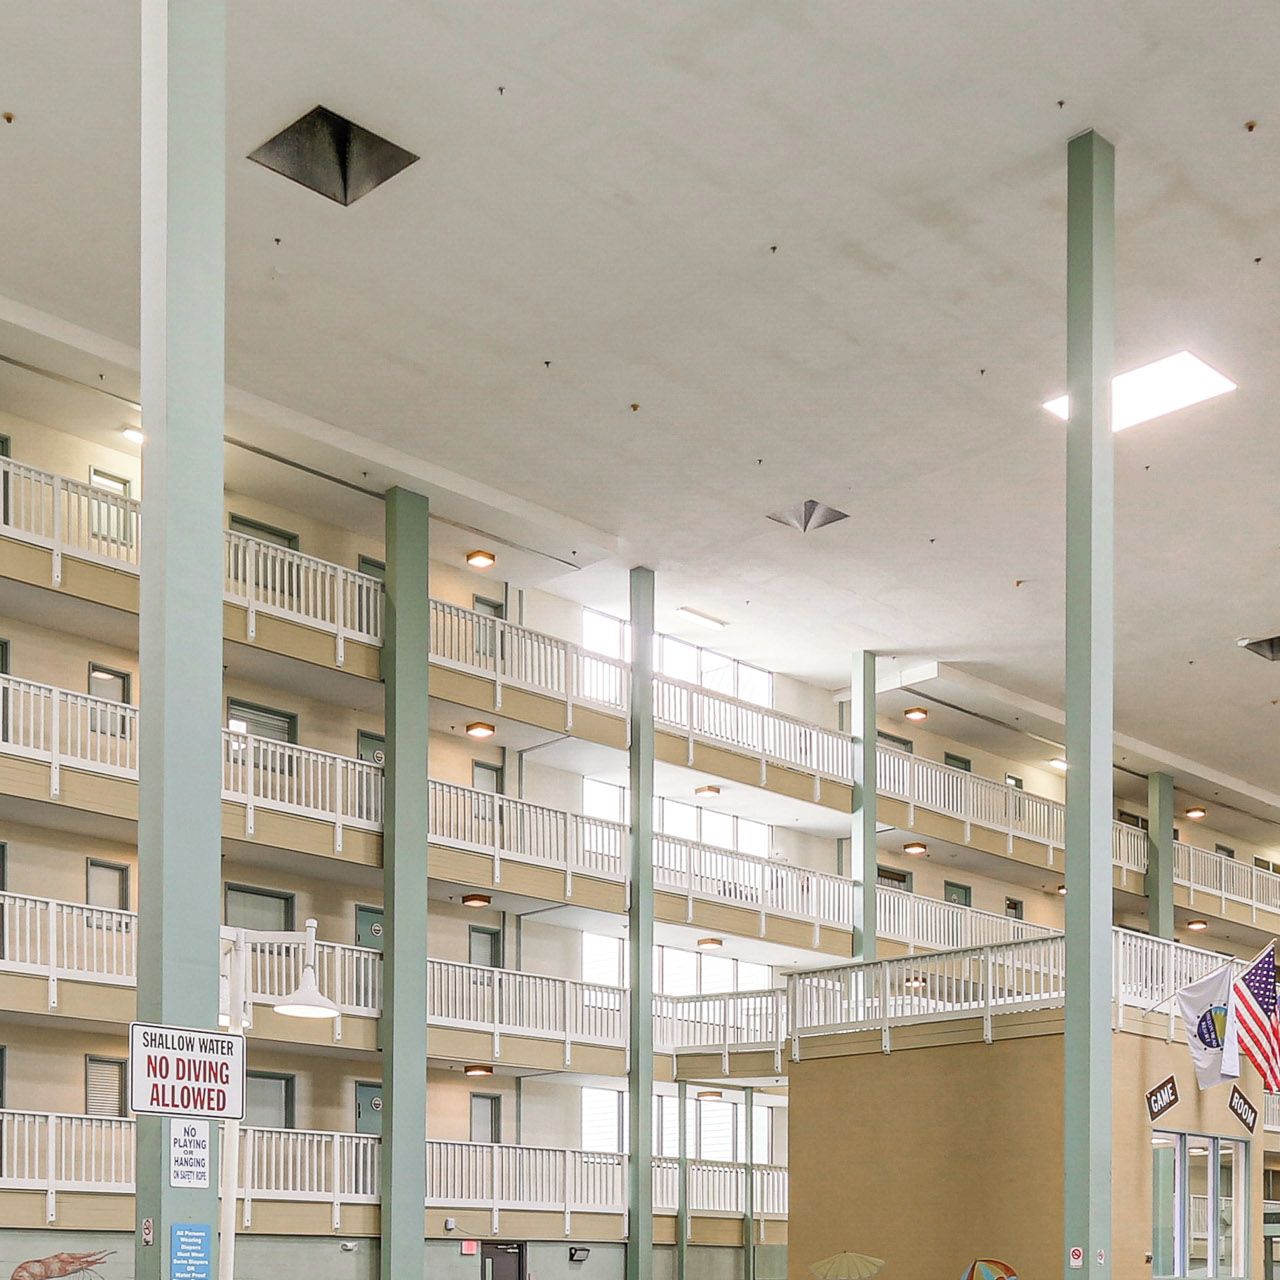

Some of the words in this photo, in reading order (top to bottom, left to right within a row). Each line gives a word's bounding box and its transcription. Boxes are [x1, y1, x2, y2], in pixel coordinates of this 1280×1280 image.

[142, 1031, 195, 1052] SHALLOW
[198, 1038, 234, 1056] WATER
[147, 1055, 169, 1079] NO
[176, 1057, 229, 1084] DIVING
[150, 1083, 226, 1111] ALLOWED
[1150, 1082, 1176, 1113] GAME
[1231, 1092, 1255, 1127] ROOM
[173, 1138, 207, 1149] PLAYING
[183, 1127, 197, 1138] NO
[173, 1157, 206, 1168] HANGING
